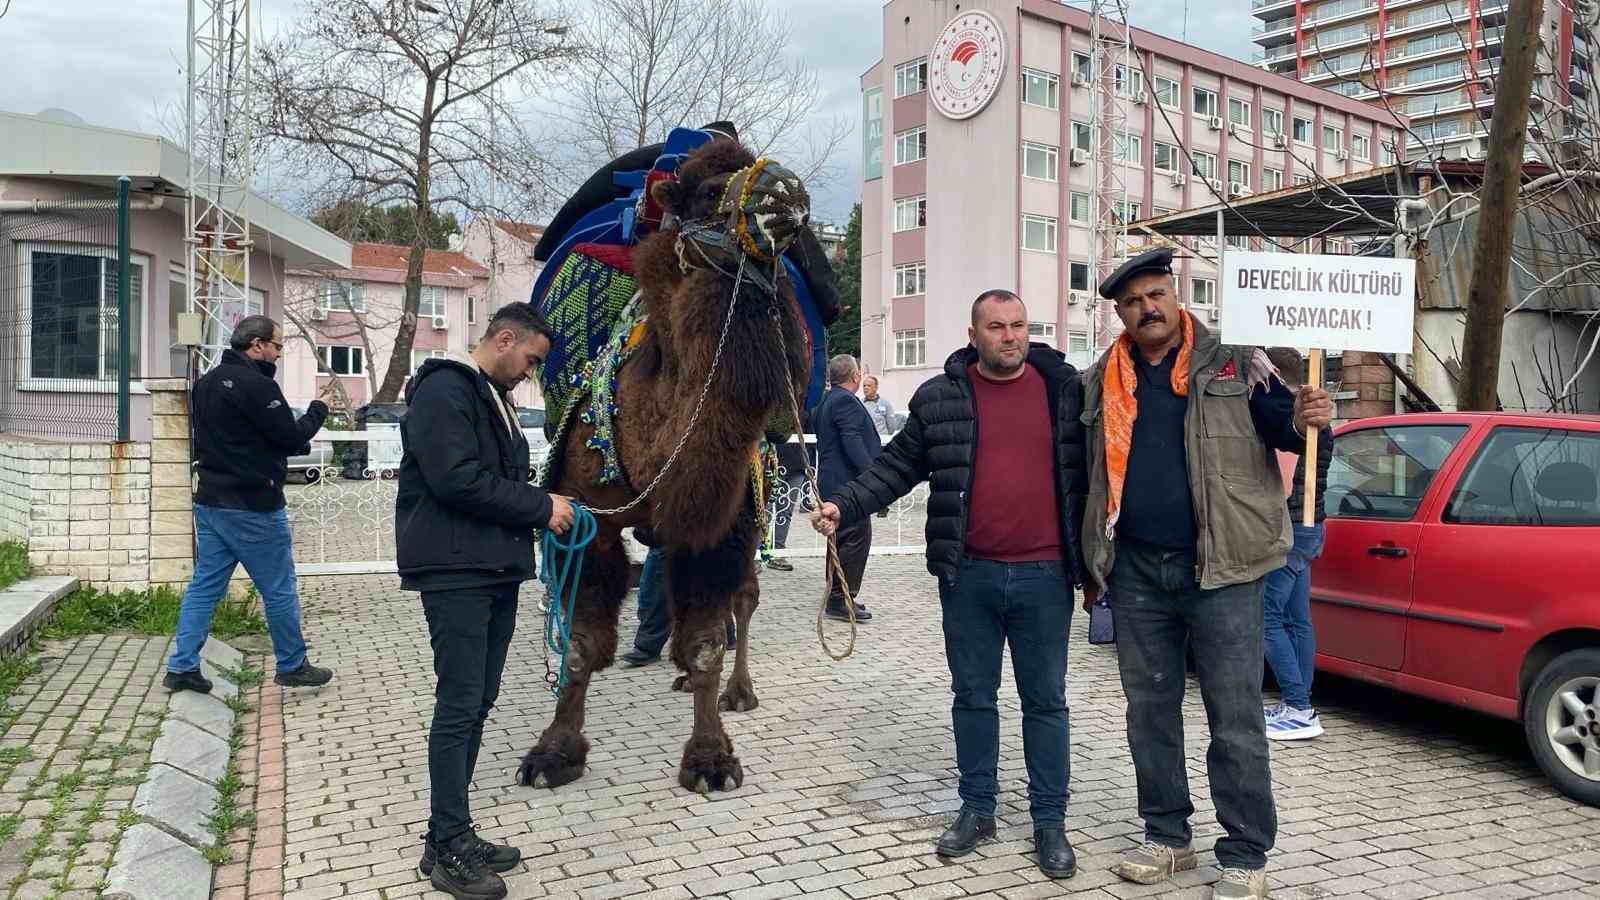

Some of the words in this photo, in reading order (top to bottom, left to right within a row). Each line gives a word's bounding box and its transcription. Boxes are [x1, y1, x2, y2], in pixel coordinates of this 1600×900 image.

[1238, 266, 1323, 292] DEVECİLİK
[1328, 268, 1402, 296] KÜLTÜRÜ
[1266, 305, 1362, 331] YAŞAYACAK
